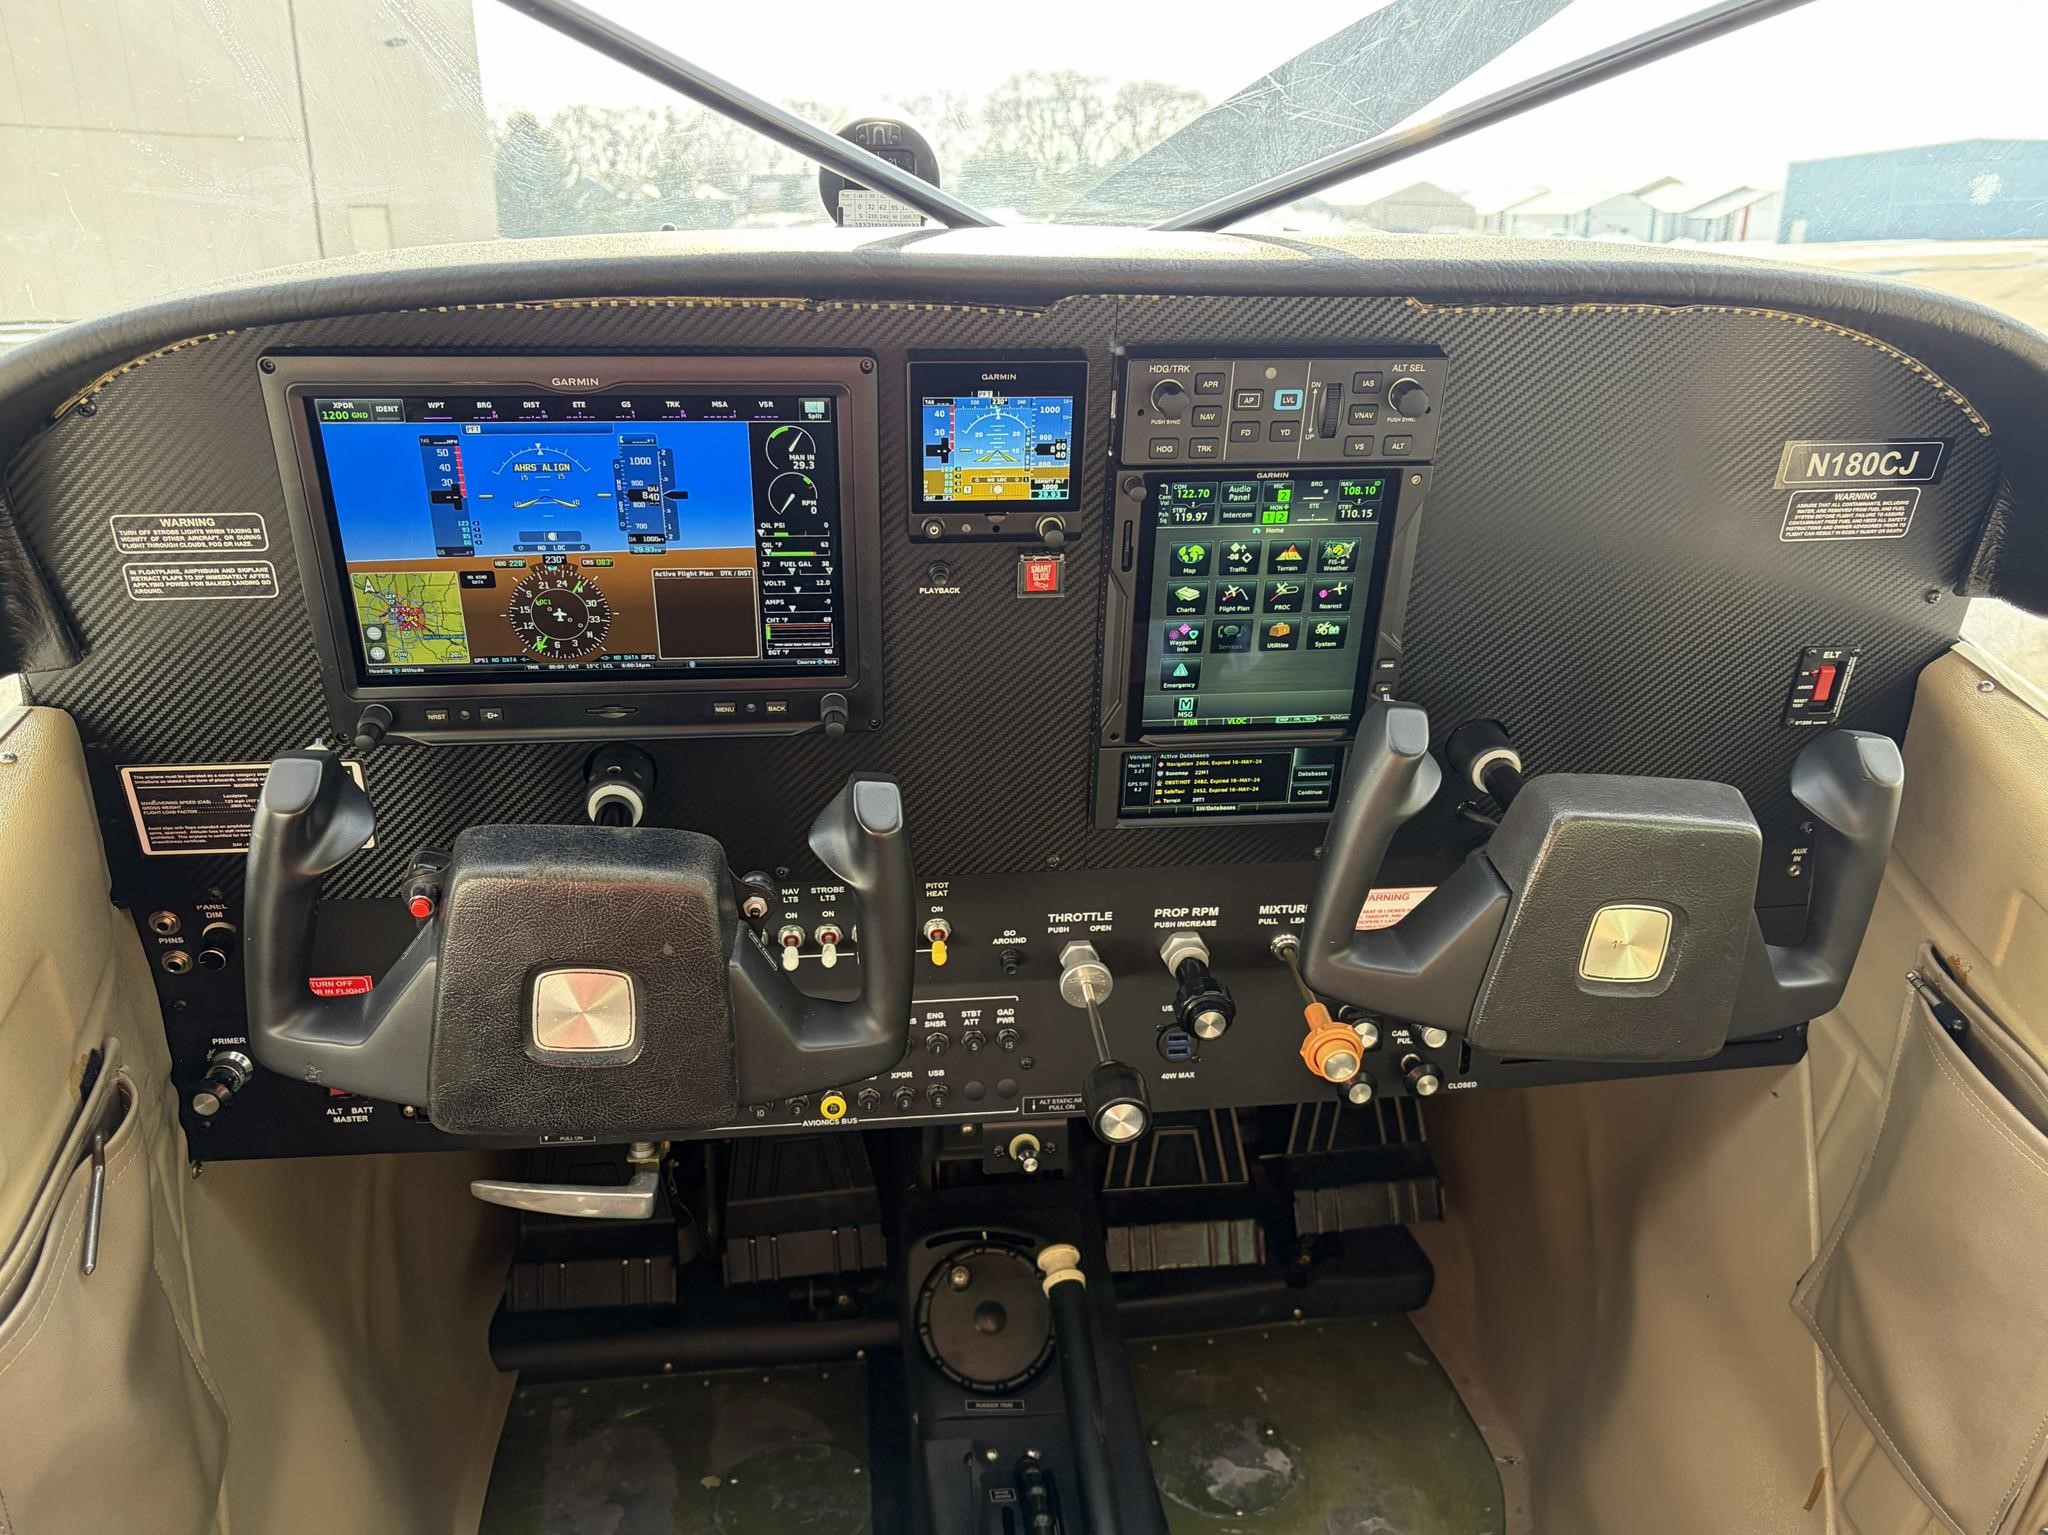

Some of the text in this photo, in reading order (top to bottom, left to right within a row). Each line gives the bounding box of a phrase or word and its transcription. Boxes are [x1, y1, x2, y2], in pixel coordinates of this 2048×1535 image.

[1149, 364, 1190, 373] HDG/TRK
[1409, 364, 1426, 372] SEL
[981, 373, 1017, 381] GARMIN
[552, 378, 599, 386] GARMIN
[1203, 380, 1218, 389] APR
[1283, 396, 1295, 404] LVL
[375, 405, 398, 413] IDENT
[322, 411, 349, 420] 1200
[808, 413, 822, 421] Split
[1200, 413, 1215, 421] NAV
[1354, 412, 1374, 420] VNAV
[1156, 445, 1172, 453] HDG
[1197, 445, 1212, 453] TRK
[1392, 442, 1404, 450] ALT
[437, 449, 449, 457] 50
[629, 457, 651, 465] 1000
[1806, 450, 1920, 477] N180CJ
[439, 464, 451, 472] 40
[514, 463, 570, 472] AHRS ALIGN
[793, 461, 815, 470] 29.3
[1176, 489, 1210, 498] 122.70
[1228, 485, 1251, 494] Audio
[1343, 486, 1376, 496] 108.10
[1228, 493, 1250, 502] Panel
[1834, 492, 1878, 501] WARNING
[1175, 511, 1208, 522] 119.97
[1223, 511, 1252, 519] Intercom
[1340, 508, 1372, 518] 110.15
[160, 518, 216, 528] WARNING
[1031, 565, 1051, 573] SMART
[1033, 573, 1050, 581] GLIDE
[1219, 605, 1236, 613] Flight
[1274, 603, 1291, 611] PROC
[1319, 602, 1342, 610] Nearest
[1170, 639, 1197, 648] Waypoint
[1823, 651, 1841, 659] ELT
[1163, 681, 1195, 689] Emergency
[810, 886, 845, 894] STROBE
[820, 894, 836, 902] LTS
[1368, 893, 1410, 901] ARNING
[205, 911, 223, 919] DIM
[1154, 906, 1219, 918] PROP RPM
[1047, 912, 1113, 923] THROTTLE
[927, 1012, 944, 1020] ENG
[961, 1010, 982, 1018] STBT
[924, 1020, 946, 1028] SNSR
[212, 1037, 246, 1046] PRIMER
[891, 1071, 913, 1079] XPDR
[928, 1069, 944, 1077] USB
[1448, 1081, 1477, 1089] CLOSED
[326, 1106, 373, 1115] ALT BATT
[333, 1115, 368, 1123] MASTER
[802, 1117, 858, 1127] AVIONICS BUS
